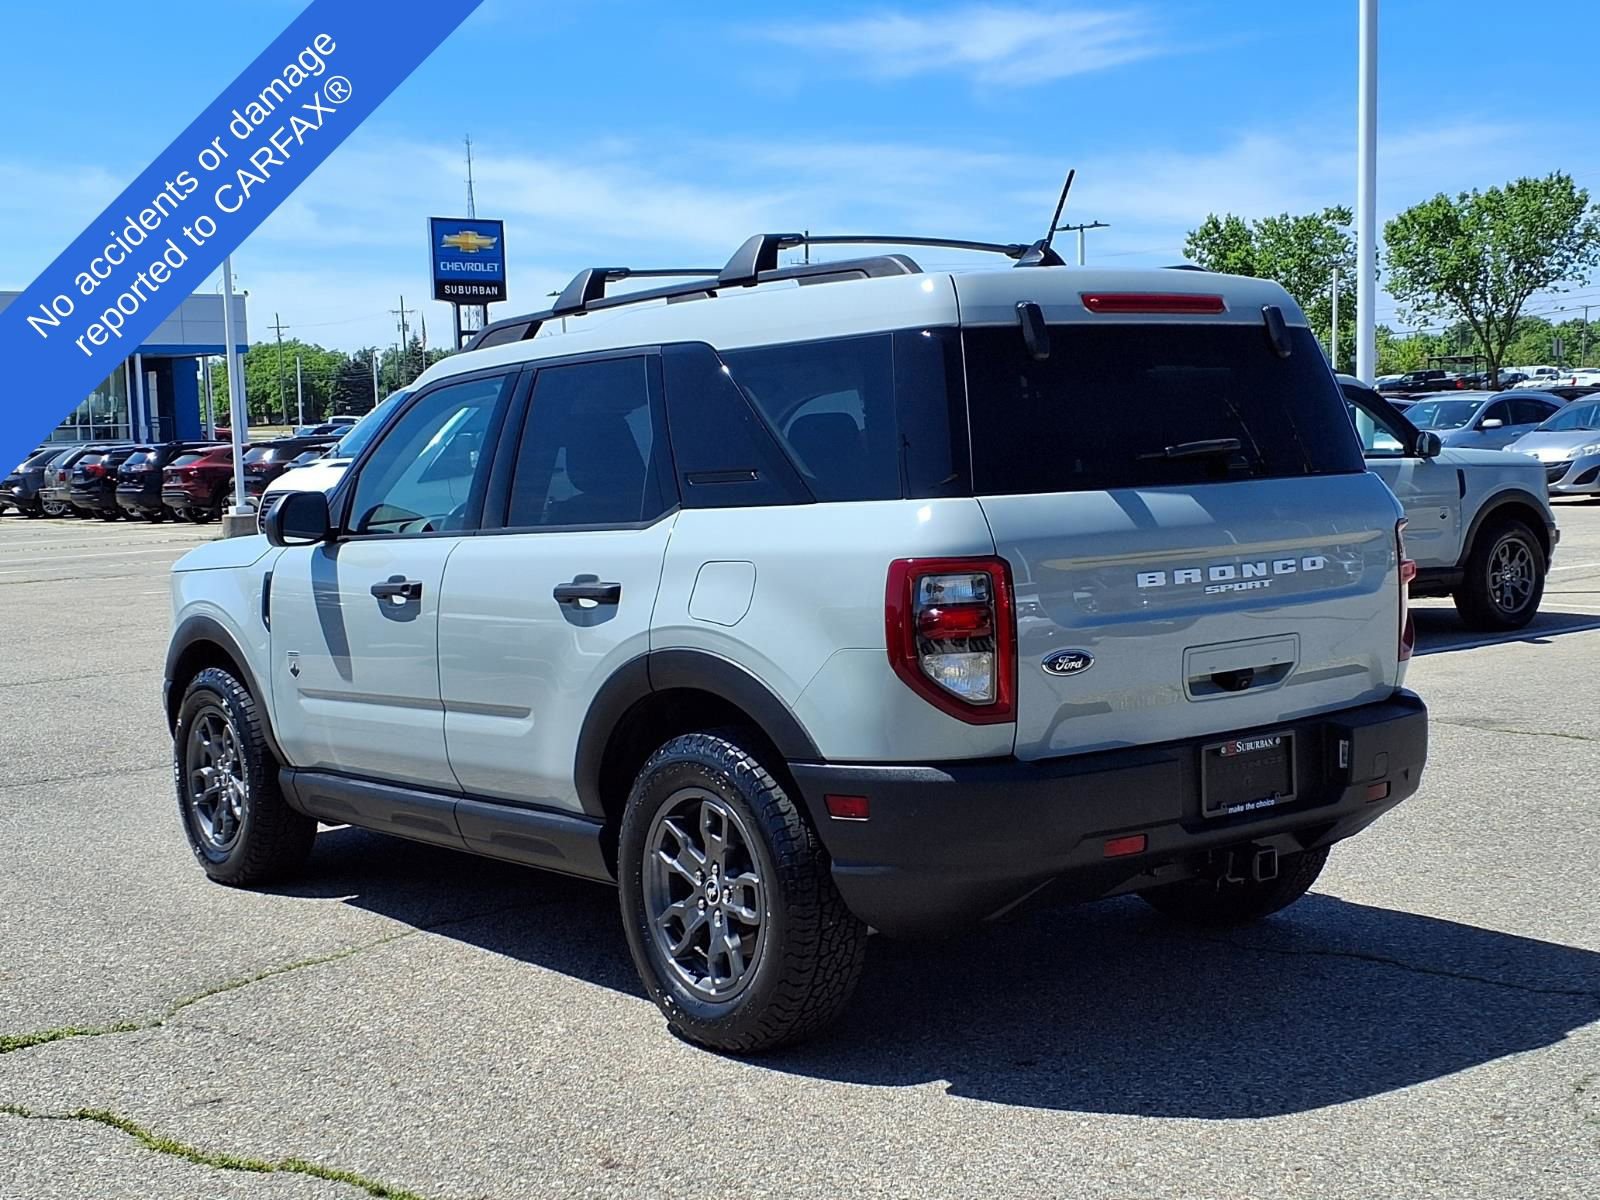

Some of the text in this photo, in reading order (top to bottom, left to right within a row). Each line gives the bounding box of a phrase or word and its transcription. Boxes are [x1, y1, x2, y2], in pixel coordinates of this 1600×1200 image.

[440, 261, 499, 273] CHEVROLET
[444, 284, 498, 296] SUBURBAN
[1136, 556, 1326, 588] BRONCO
[1204, 579, 1273, 595] SPORT
[1055, 655, 1084, 671] Ford
[1228, 798, 1275, 814] make the choice
